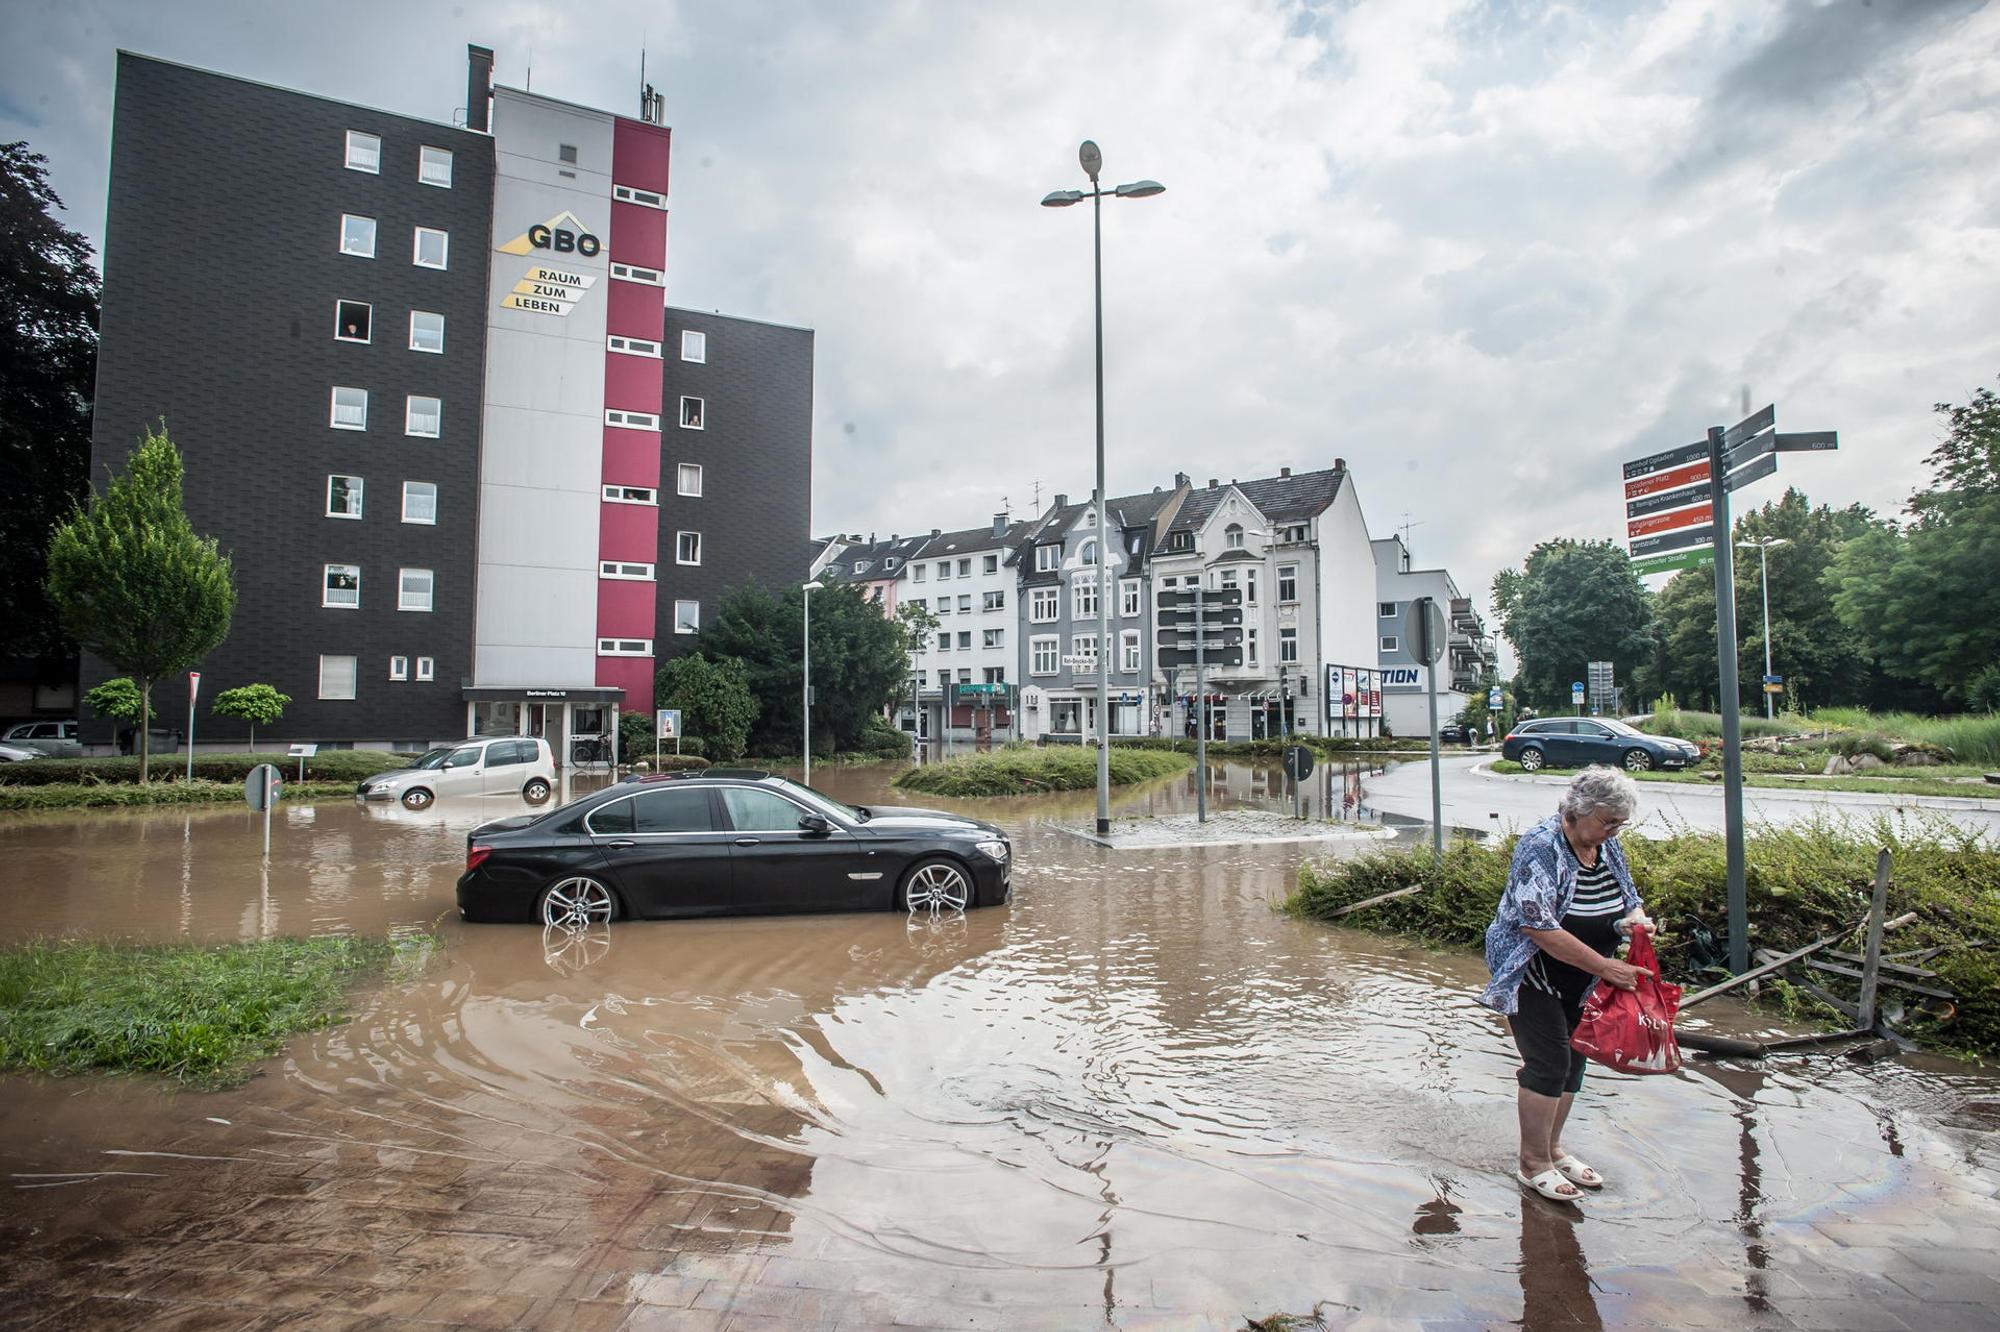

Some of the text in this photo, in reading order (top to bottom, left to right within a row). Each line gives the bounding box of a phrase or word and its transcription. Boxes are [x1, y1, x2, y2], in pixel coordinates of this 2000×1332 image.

[528, 225, 601, 257] GBO
[538, 270, 581, 285] RAUM
[533, 284, 566, 298] ZUM
[515, 297, 560, 313] LEBEN
[1649, 453, 1674, 464] Opladen
[1686, 453, 1700, 461] 1000
